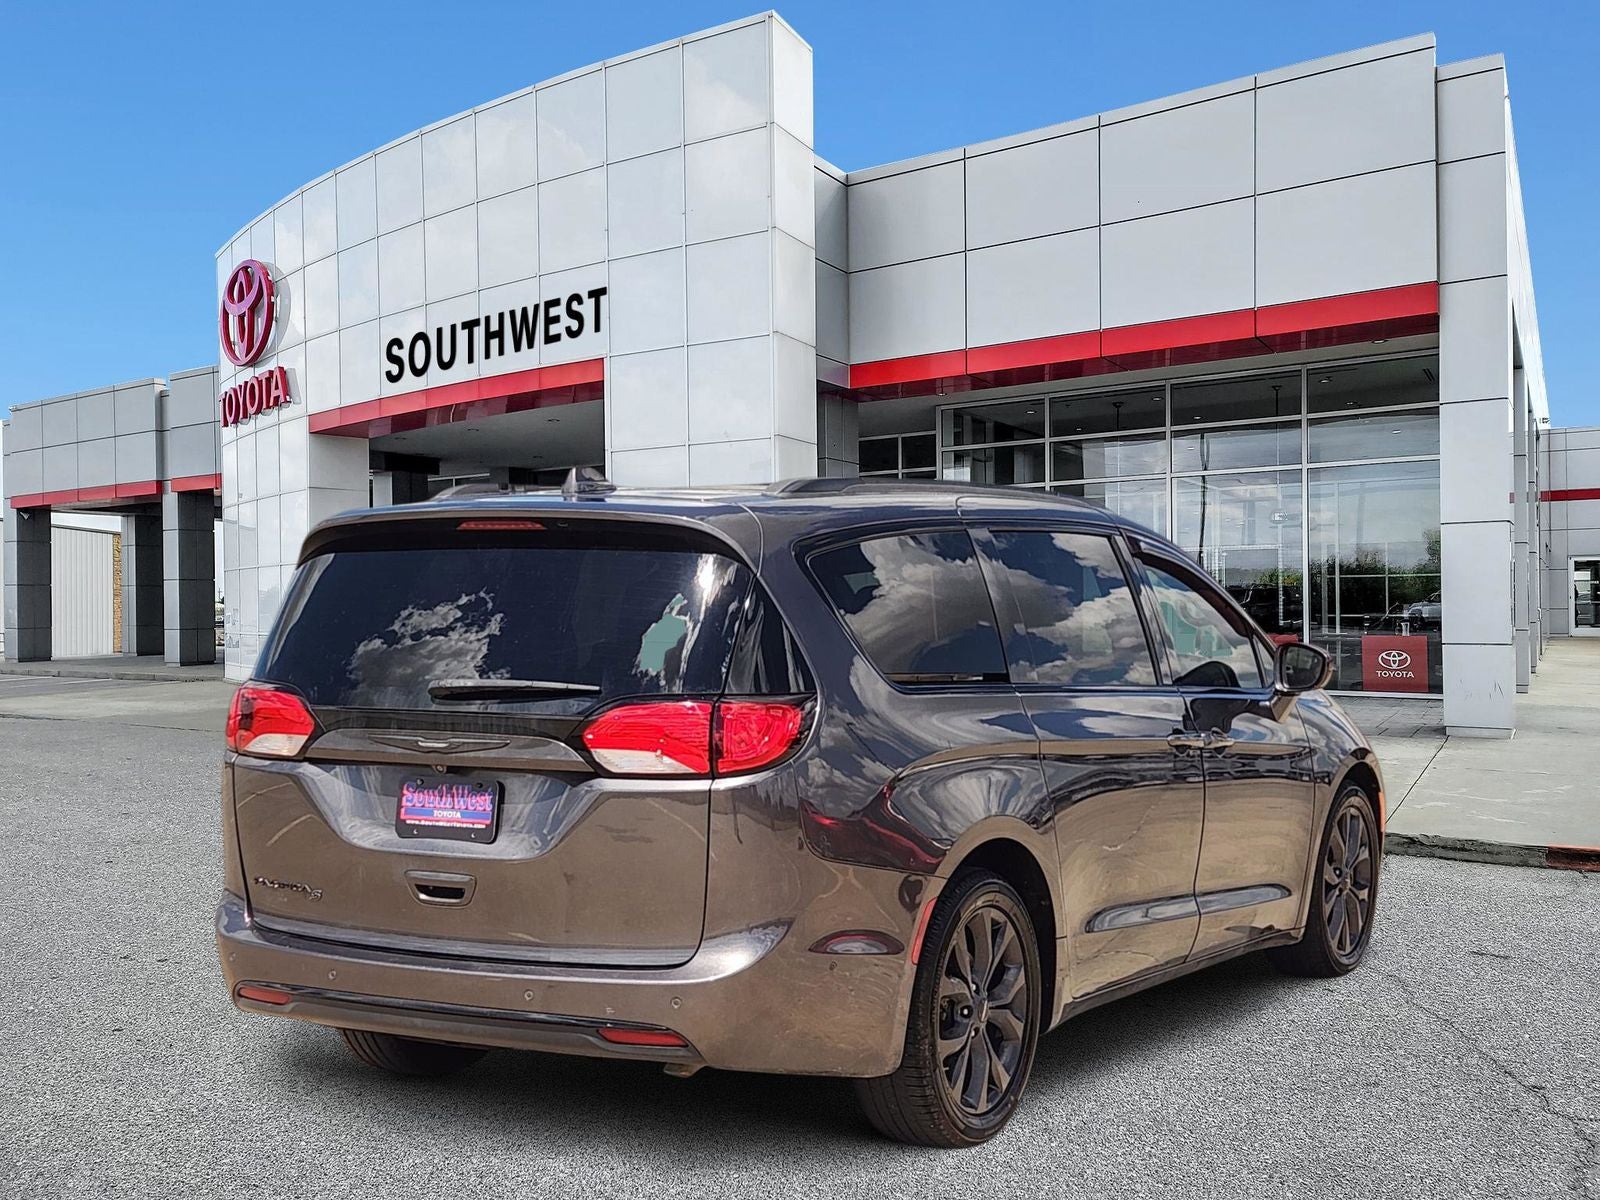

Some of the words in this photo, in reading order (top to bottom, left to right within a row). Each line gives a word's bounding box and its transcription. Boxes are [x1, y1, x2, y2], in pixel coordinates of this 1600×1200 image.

[385, 286, 607, 383] SOUTHWEST
[219, 366, 289, 428] TOYOTA
[1375, 670, 1415, 678] TOYOTA
[433, 809, 462, 819] TOYOTA
